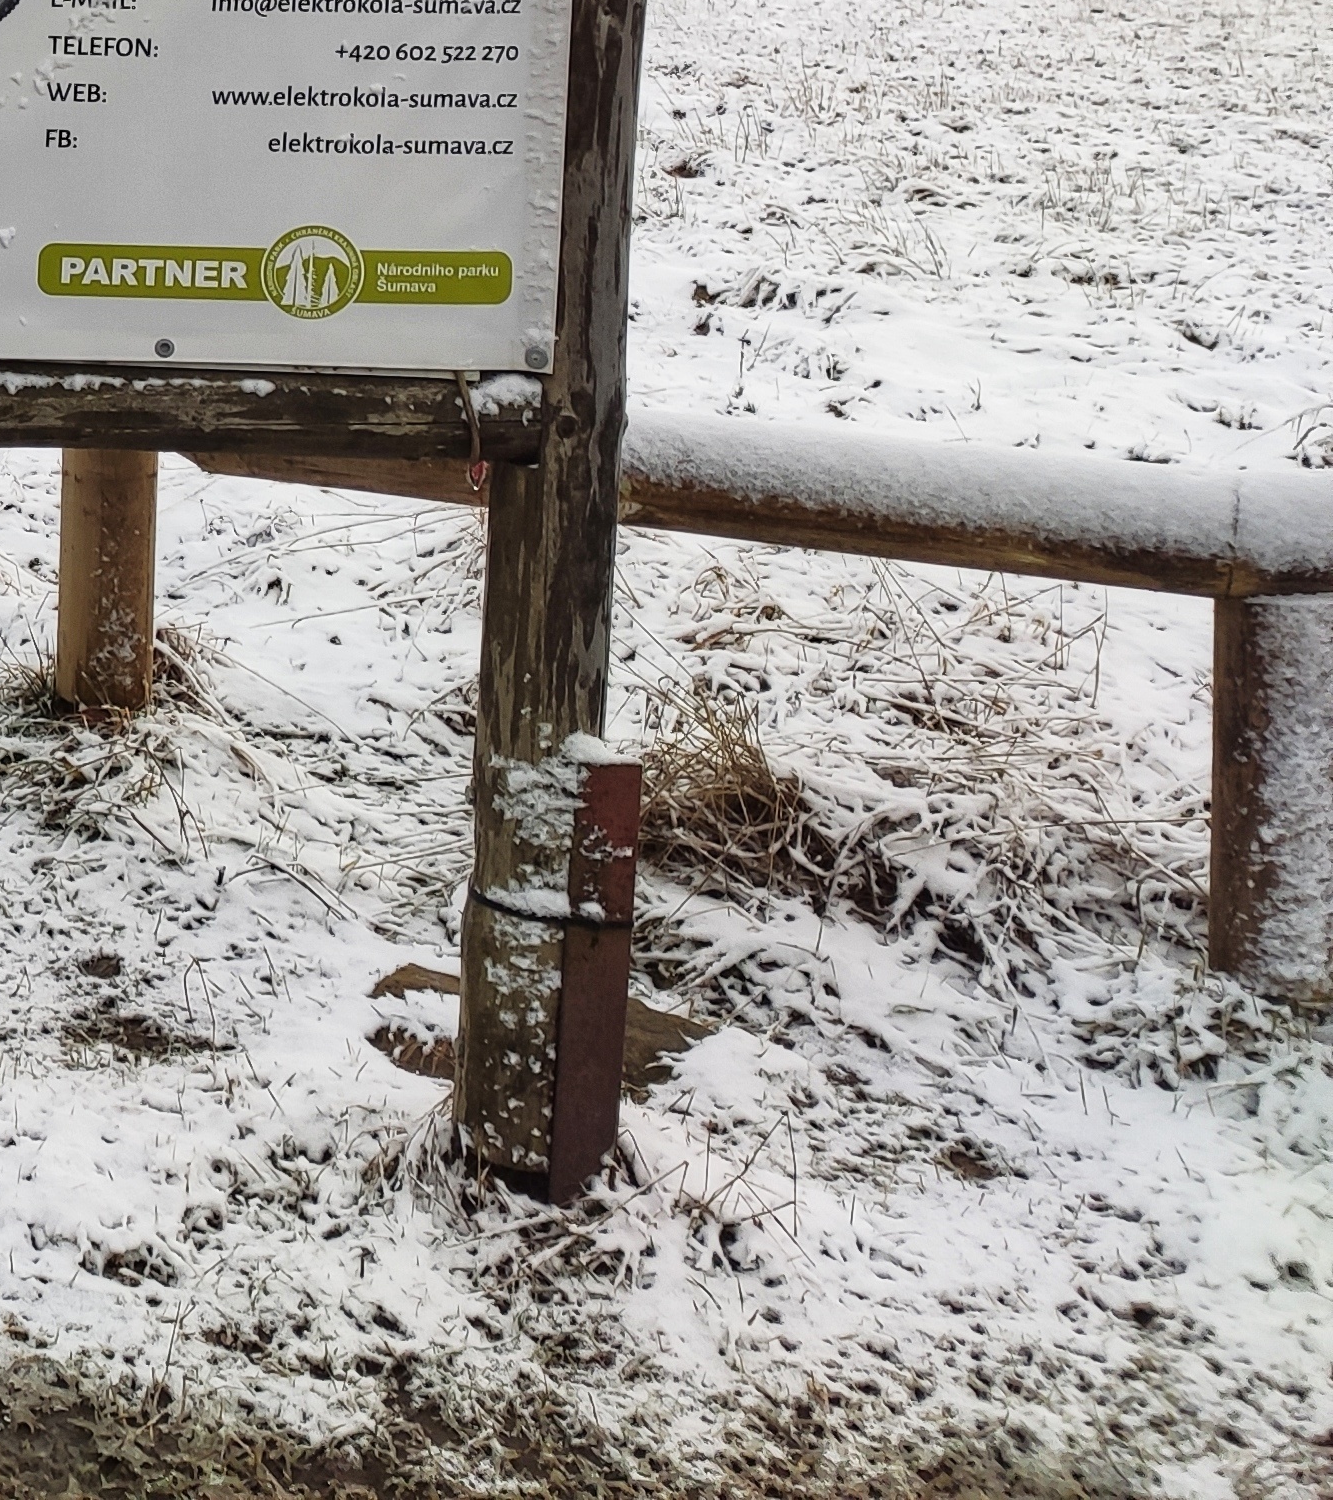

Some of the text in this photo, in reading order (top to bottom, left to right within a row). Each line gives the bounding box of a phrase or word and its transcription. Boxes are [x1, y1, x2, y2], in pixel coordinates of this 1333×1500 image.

[47, 35, 519, 64] TELEFON: +420 602 522 270
[46, 81, 518, 109] WEB: www.elektrokola-sumava.cz
[45, 128, 514, 155] FB: elektrokola-sumava.cz
[60, 257, 248, 289] PARTNER
[376, 276, 437, 293] Šumava
[457, 264, 501, 281] parku
